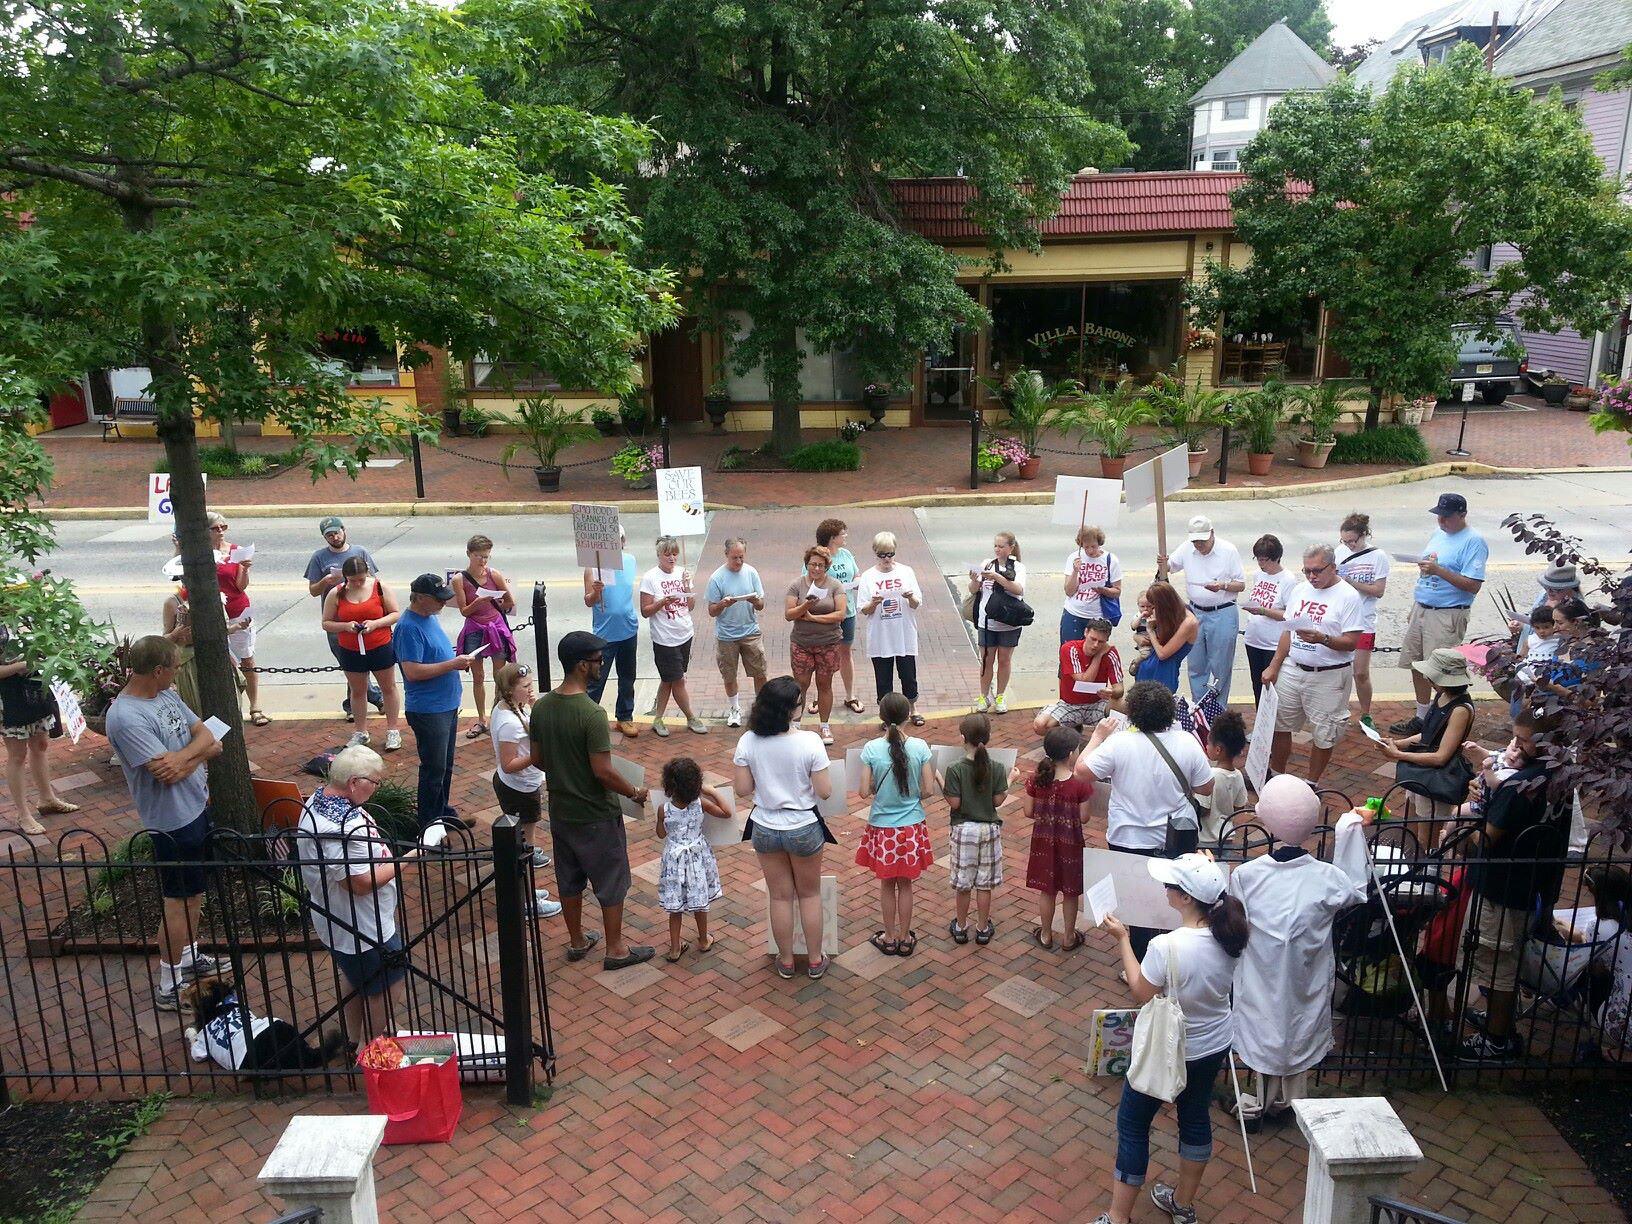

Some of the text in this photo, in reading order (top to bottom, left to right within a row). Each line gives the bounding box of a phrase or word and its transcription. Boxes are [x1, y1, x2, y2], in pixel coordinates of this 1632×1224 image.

[1027, 323, 1137, 348] VILLA BARONE
[665, 469, 696, 480] SAVE
[669, 479, 693, 490] OUR
[665, 489, 696, 501] BEES
[608, 516, 619, 525] OR
[600, 524, 607, 532] IN
[610, 525, 620, 534] 50
[1353, 574, 1376, 582] FREE
[876, 579, 902, 590] YES
[1300, 600, 1328, 615] YES
